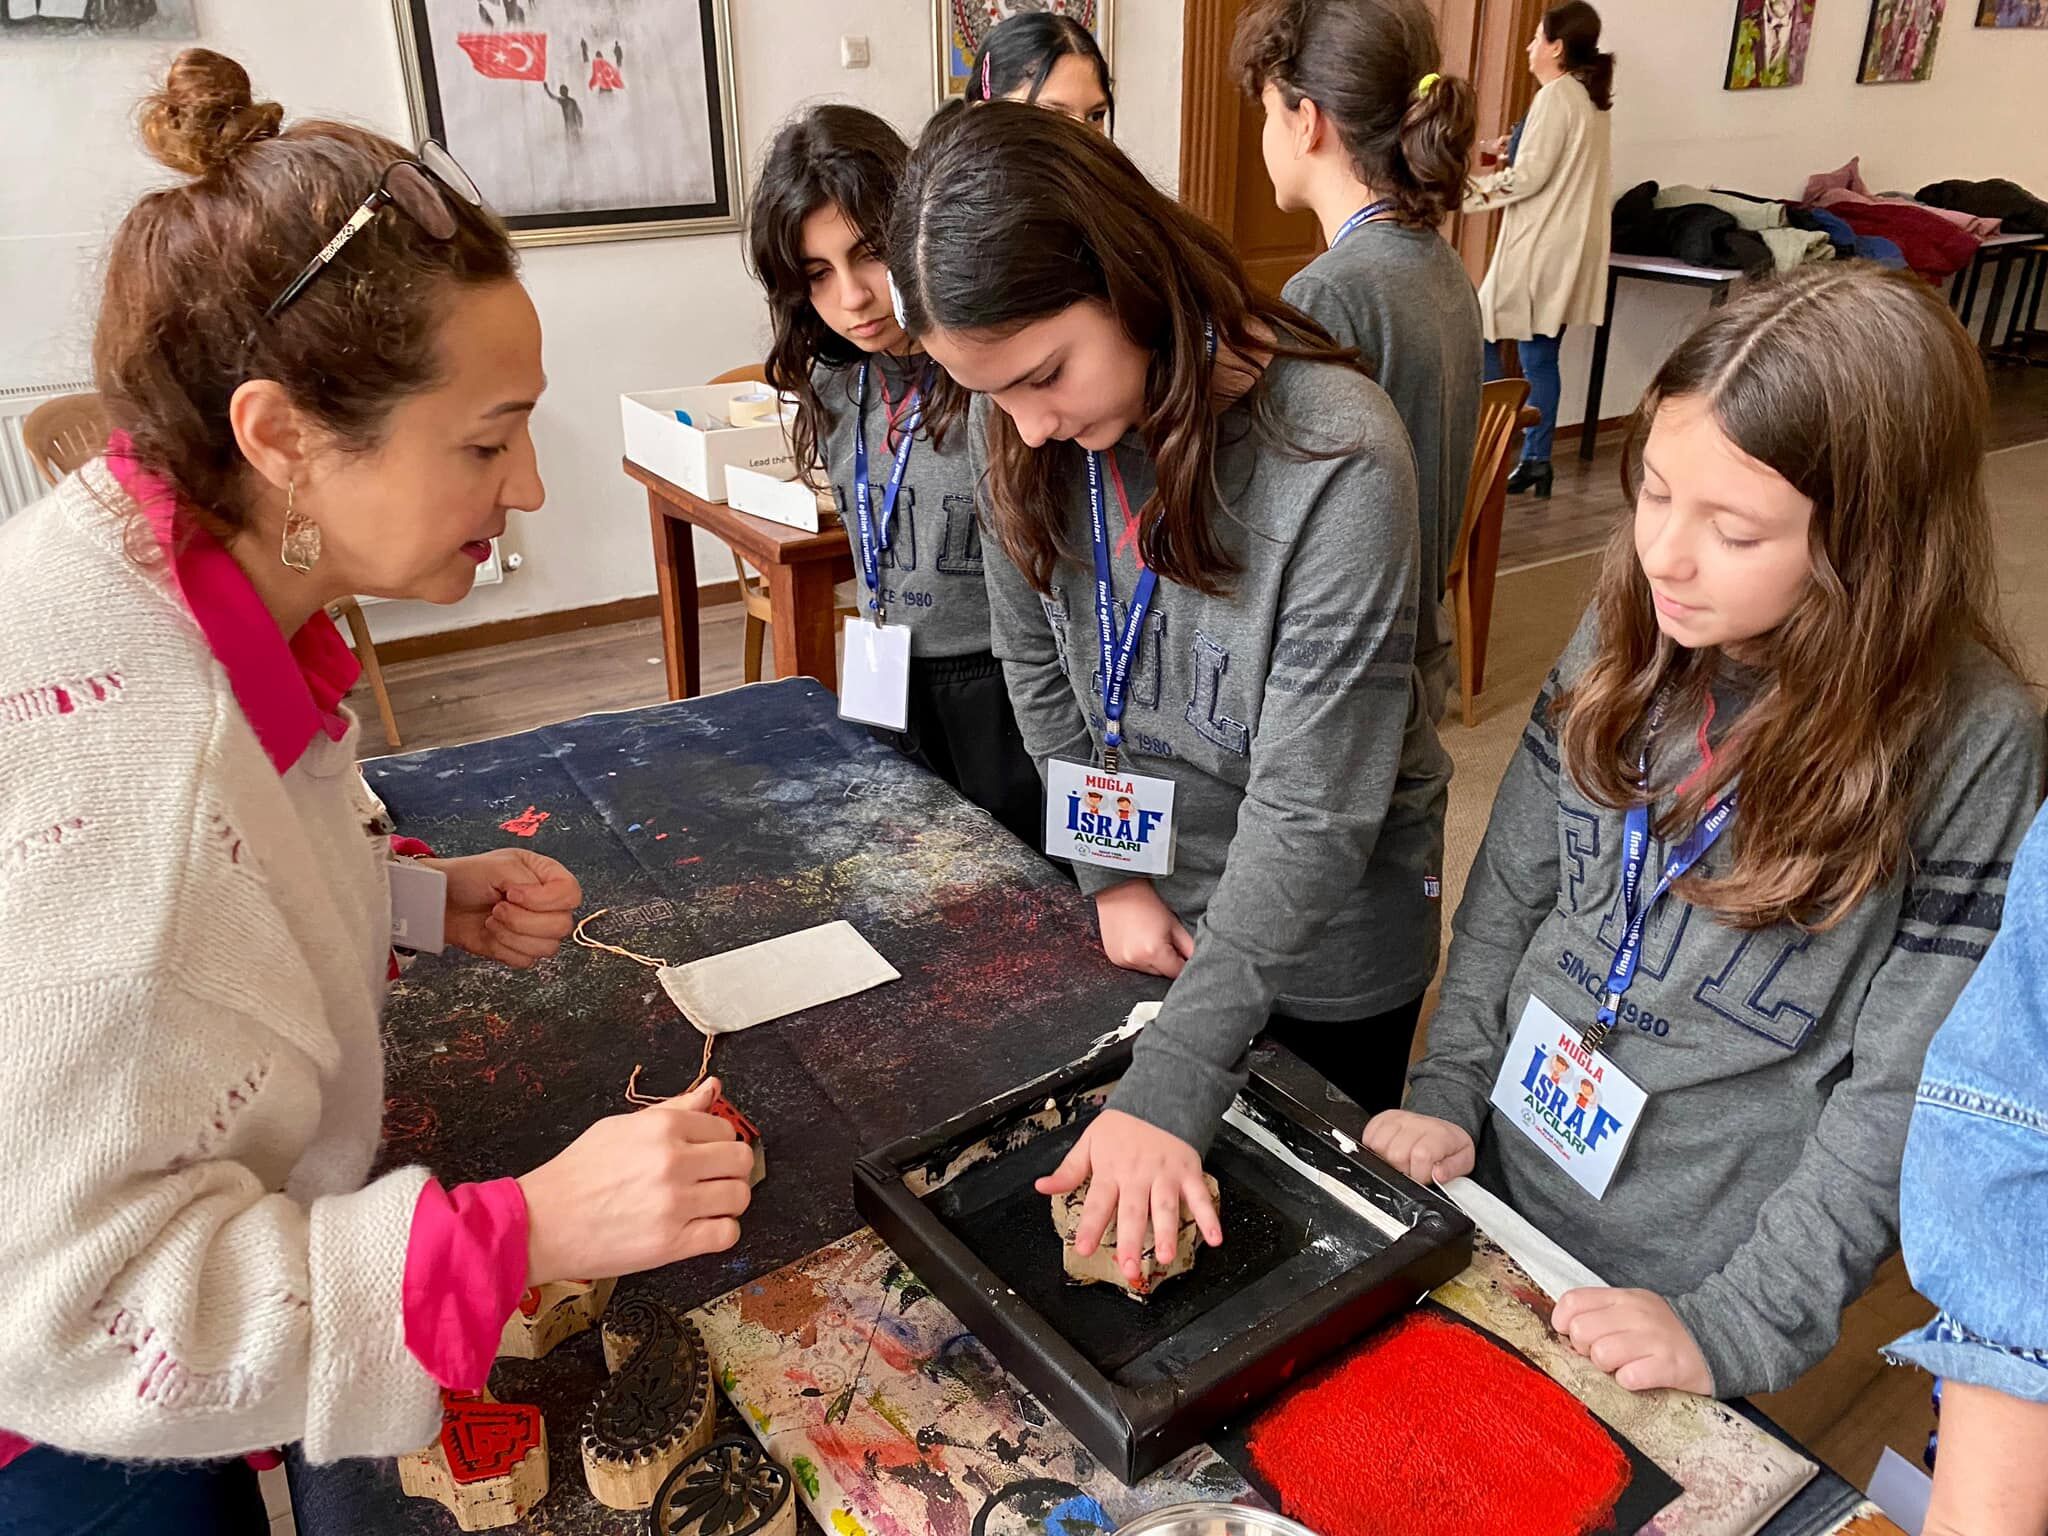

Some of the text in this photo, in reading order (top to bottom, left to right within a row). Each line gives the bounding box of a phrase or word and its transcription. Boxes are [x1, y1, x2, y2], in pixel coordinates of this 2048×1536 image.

[749, 456, 770, 467] Lead
[901, 591, 933, 607] 1980
[1110, 683, 1121, 705] final
[1135, 733, 1172, 758] 1980
[1074, 832, 1141, 852] AVCILARI
[1628, 830, 1643, 860] final
[1614, 949, 1633, 976] final
[1523, 1094, 1588, 1155] AVCILARI
